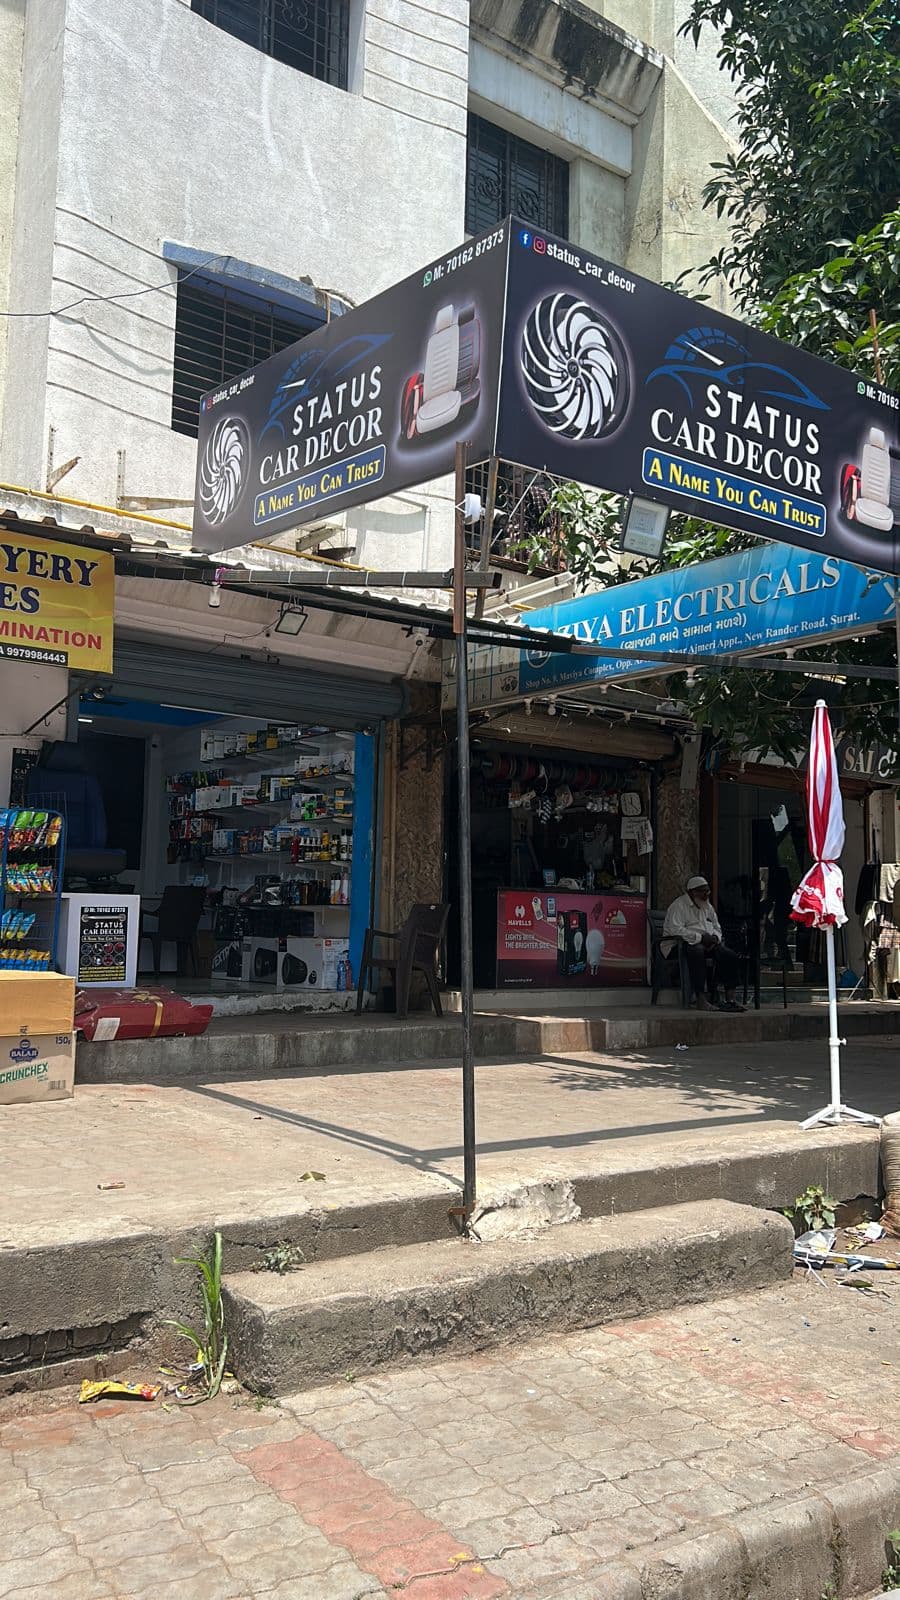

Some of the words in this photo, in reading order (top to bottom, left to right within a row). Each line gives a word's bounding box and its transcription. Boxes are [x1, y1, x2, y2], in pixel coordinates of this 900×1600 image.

[433, 265, 445, 281] M:
[446, 246, 474, 274] 70162
[475, 228, 504, 257] 87373
[546, 243, 636, 294] status_car_decor
[292, 365, 383, 437] STATUS
[866, 384, 876, 400] M:
[877, 390, 900, 410] 70162
[705, 384, 820, 455] STATUS
[260, 444, 300, 485] CAR
[303, 406, 383, 468] DECOR
[650, 408, 718, 460] CAR
[723, 431, 823, 495] DECOR
[649, 457, 663, 481] A
[257, 500, 266, 518] A
[0, 543, 98, 587] YERY
[0, 581, 40, 614] ES
[618, 555, 842, 637] ELECTRICALS
[615, 659, 633, 671] Opp.
[744, 632, 763, 643] New
[765, 624, 799, 639] Rander
[830, 612, 860, 626] Surat.
[659, 626, 679, 643] ભાવે
[682, 622, 712, 638] સામાન
[6, 646, 67, 664] 9979984443
[94, 921, 124, 929] STATUS
[507, 919, 532, 927] HAVELLS
[0, 1061, 49, 1084] CRUNCHEX
